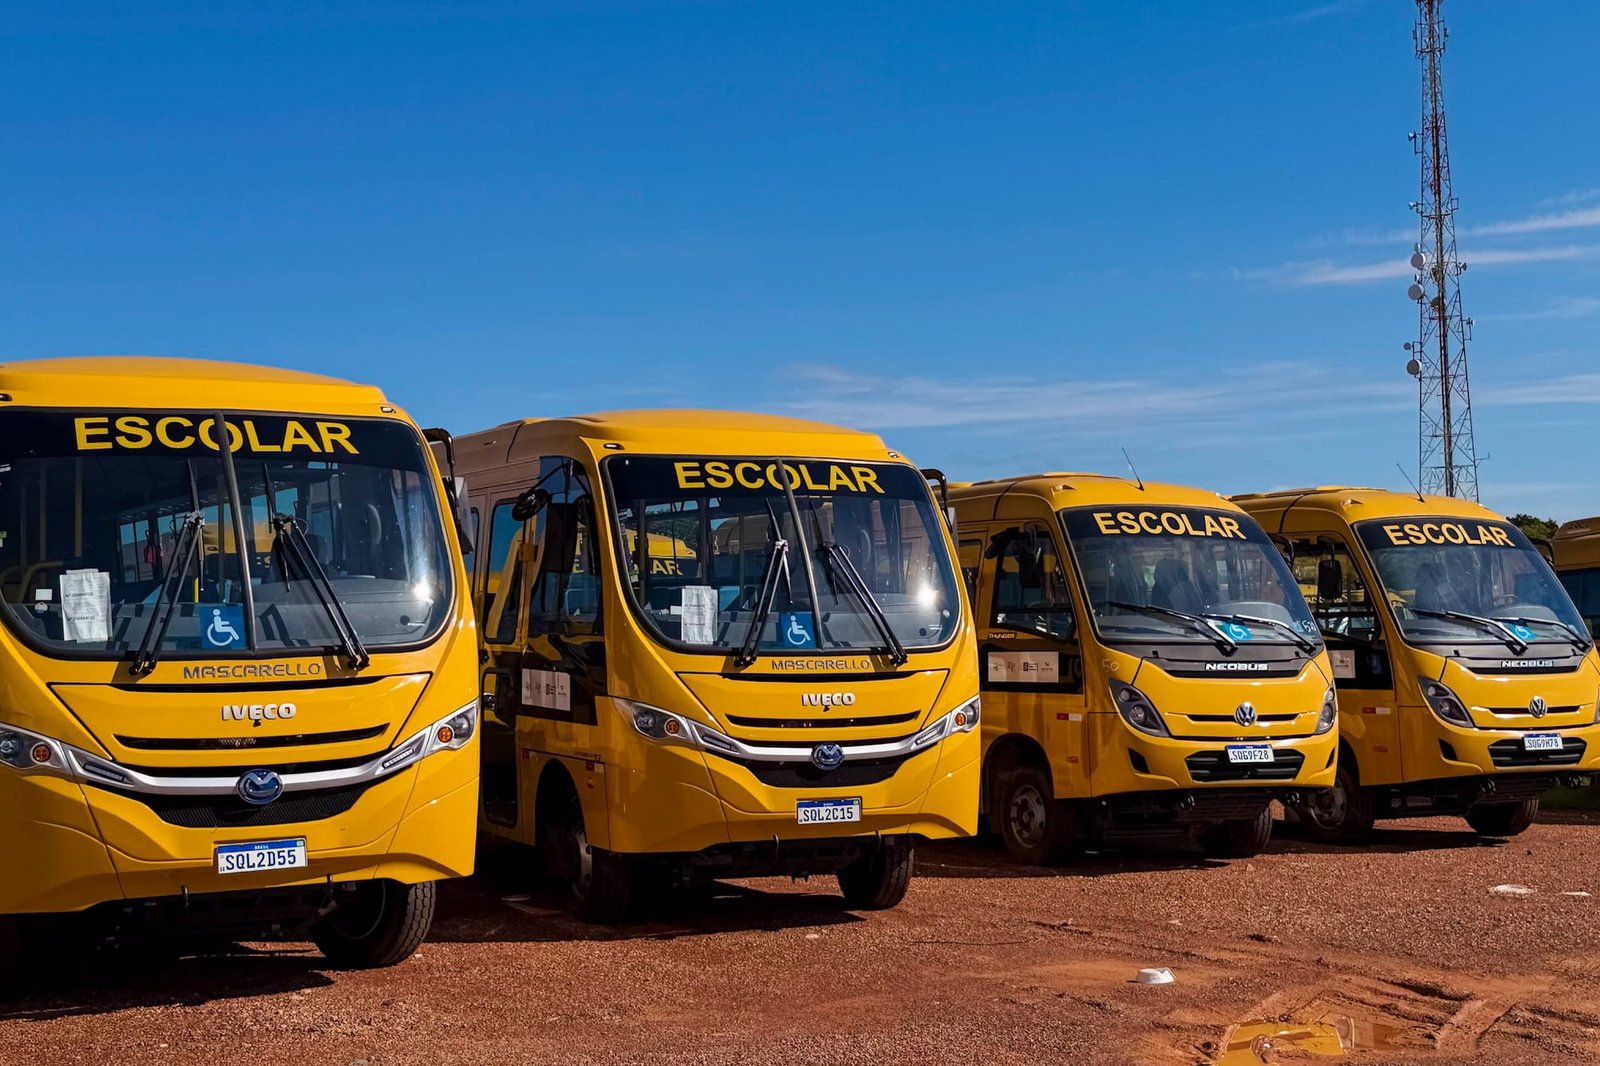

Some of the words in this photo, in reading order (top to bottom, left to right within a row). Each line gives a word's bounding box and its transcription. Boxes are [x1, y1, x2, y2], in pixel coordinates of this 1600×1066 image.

[73, 416, 360, 454] ESCOLAR
[674, 461, 885, 494] ESCOLAR
[1092, 511, 1248, 540] ESCOLAR
[1382, 522, 1516, 548] ESCOLAR
[183, 663, 322, 679] MASCARELLO
[771, 659, 870, 671] MASCARELLO
[1205, 662, 1268, 671] NEOBUS
[801, 692, 856, 706] IVECO
[221, 703, 297, 720] IVECO
[803, 807, 854, 822] SQL2C15
[226, 849, 297, 870] SQL2D55
